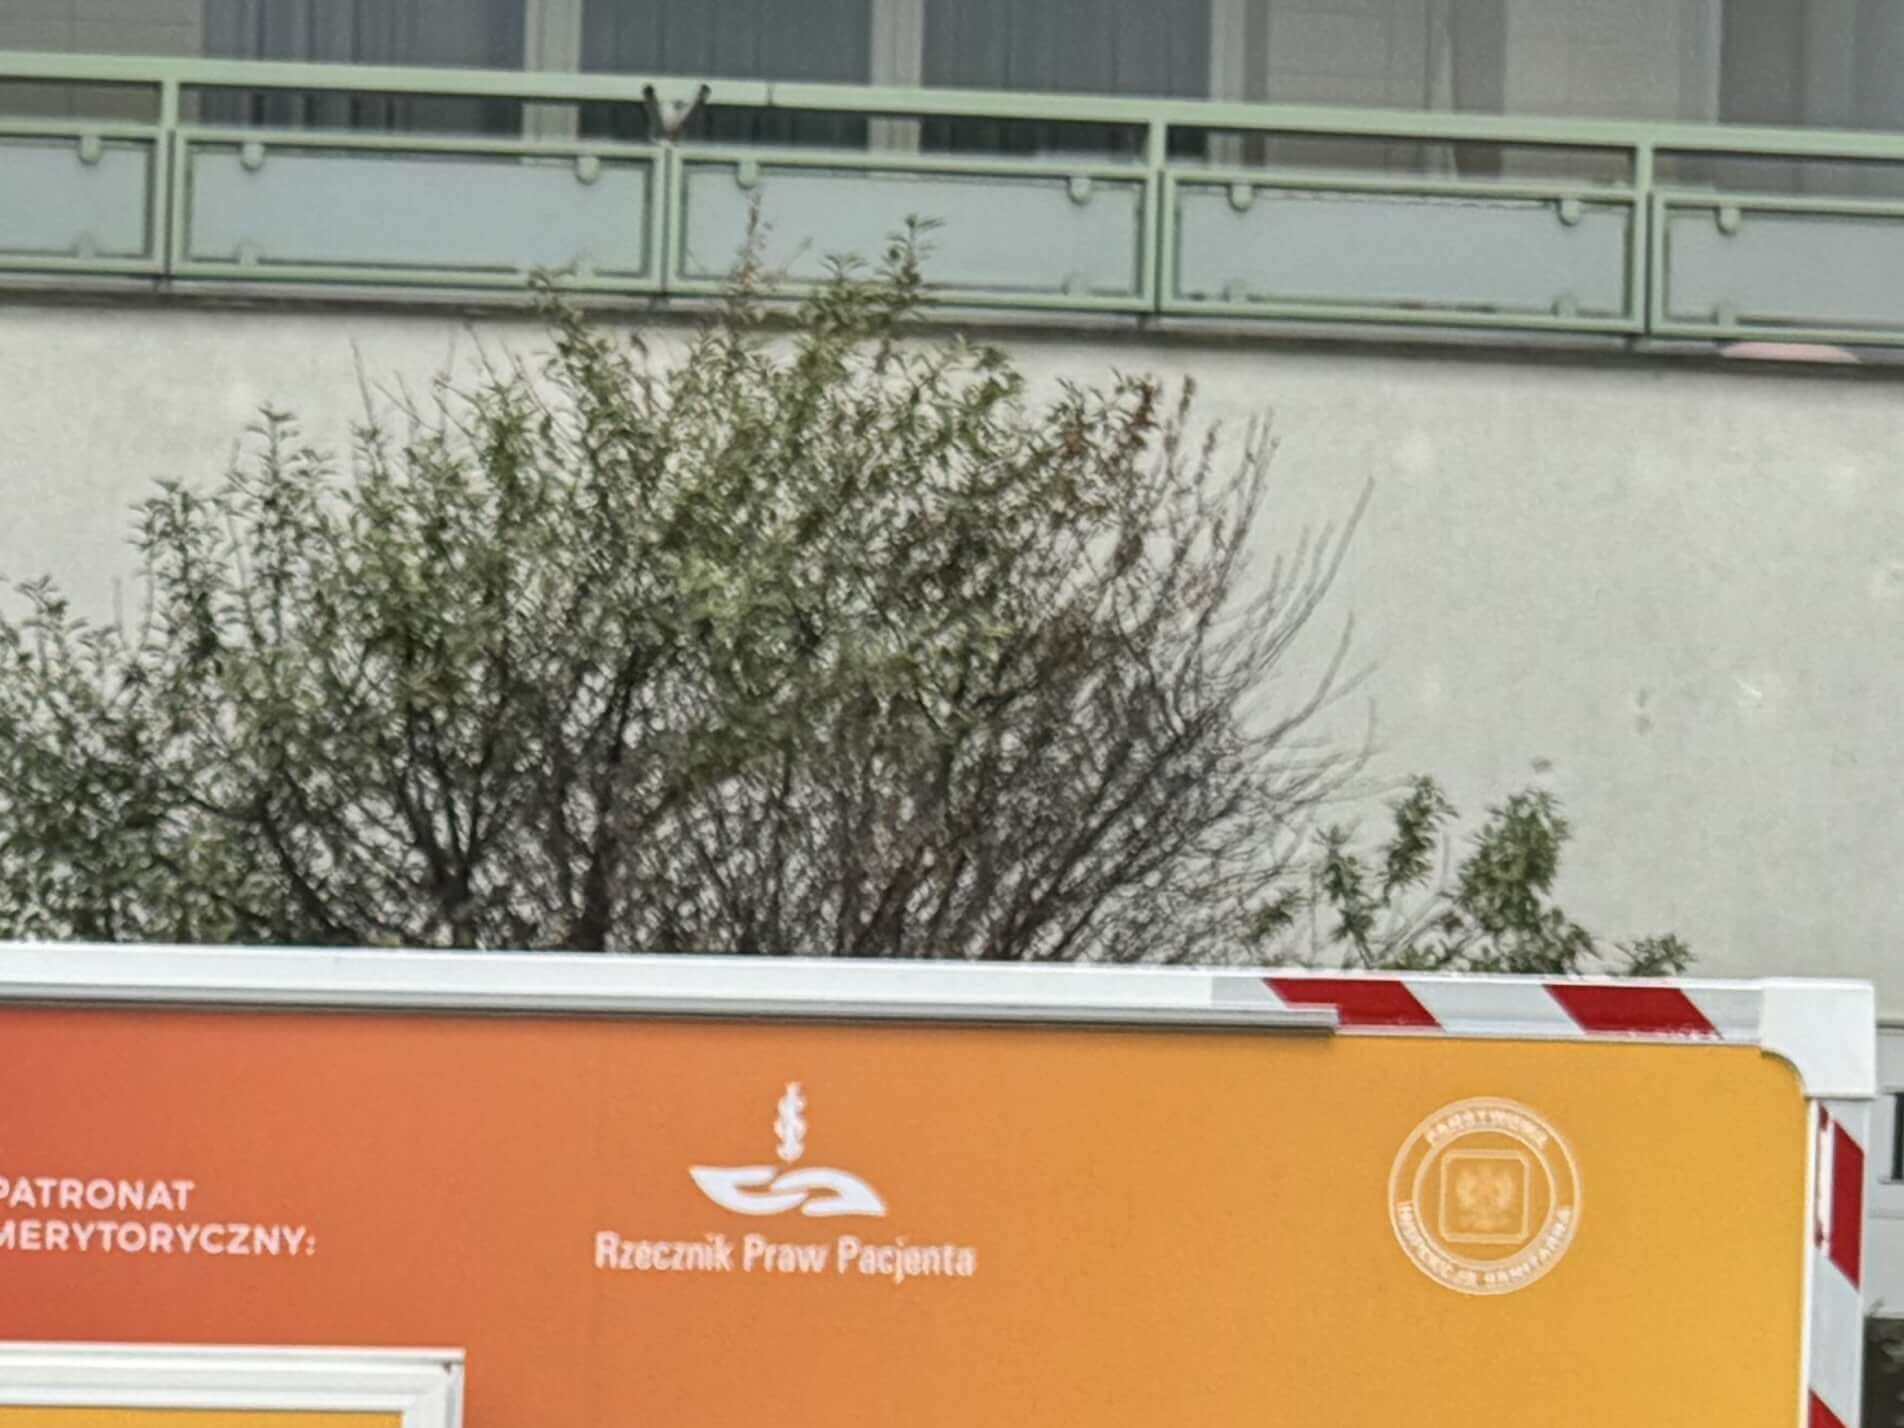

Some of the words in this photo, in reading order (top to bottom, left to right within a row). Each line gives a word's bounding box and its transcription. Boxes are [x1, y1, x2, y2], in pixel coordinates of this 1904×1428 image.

[594, 1230, 735, 1272] Rzecznik
[743, 1232, 829, 1274] Praw
[837, 1234, 977, 1285] Pacjenta
